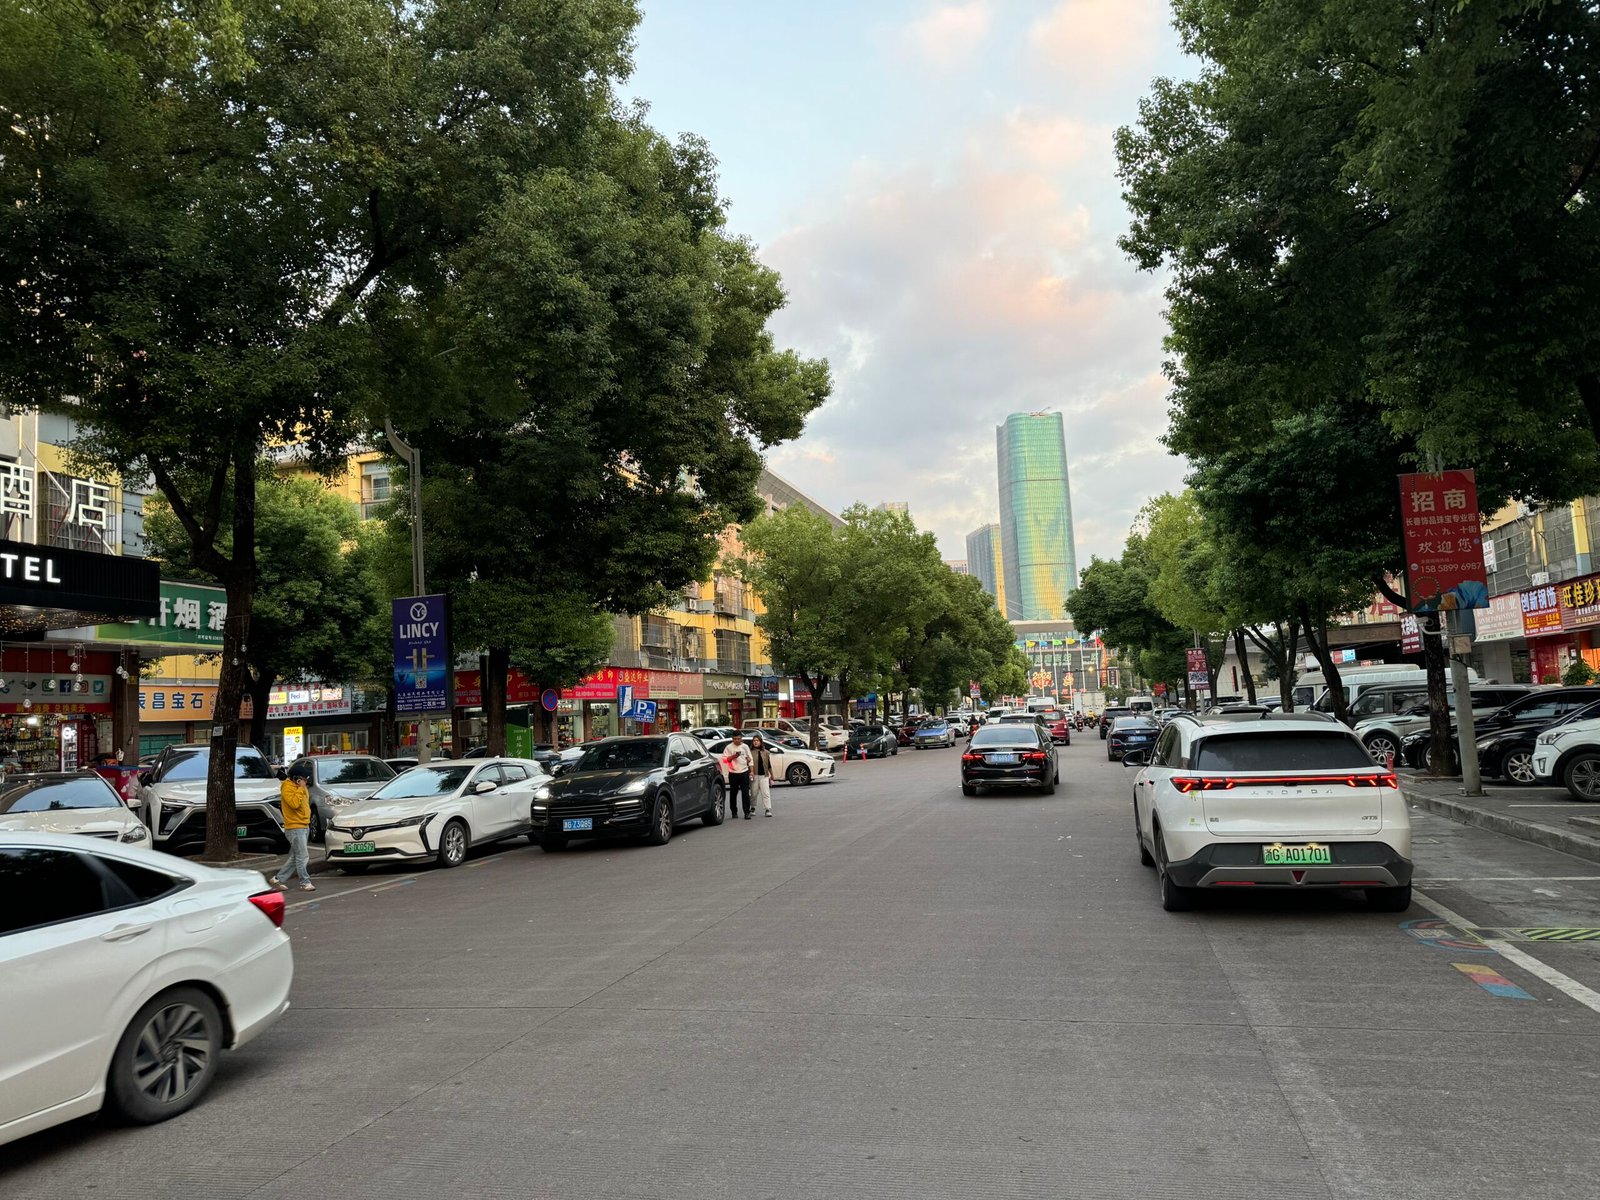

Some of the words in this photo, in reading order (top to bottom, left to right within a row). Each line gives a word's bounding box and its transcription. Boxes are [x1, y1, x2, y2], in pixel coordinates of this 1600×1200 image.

[1411, 489, 1467, 512] 招商
[1417, 537, 1472, 553] 欢迎您
[0, 553, 61, 583] TEL
[1421, 565, 1436, 573] 158
[1438, 563, 1459, 572] 5899
[1460, 562, 1482, 571] 6987
[400, 622, 439, 639] LINCY
[637, 701, 648, 714] P
[1285, 848, 1329, 862] A01701
